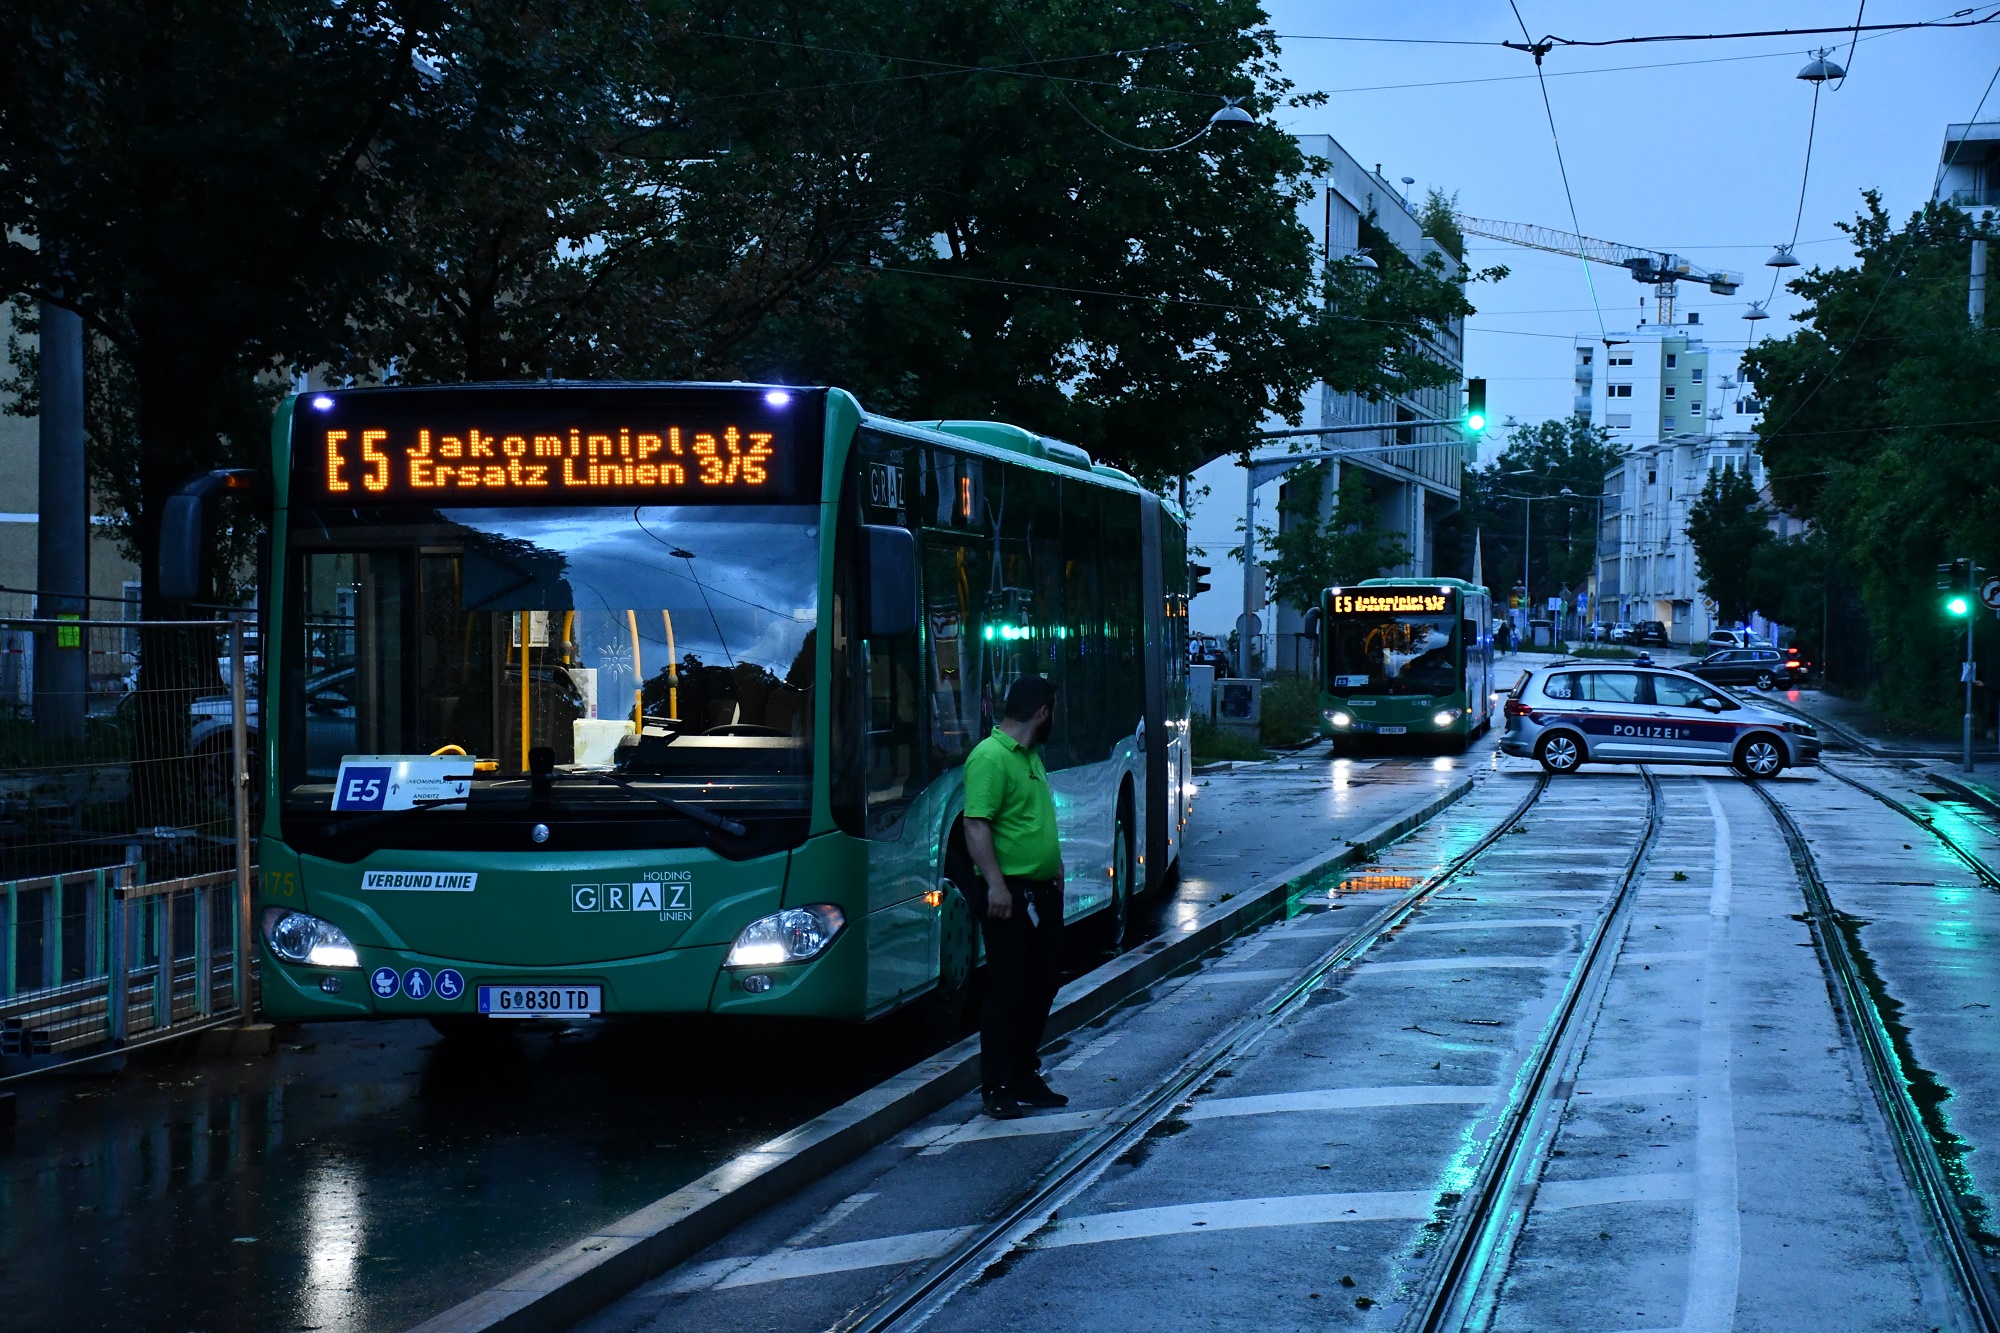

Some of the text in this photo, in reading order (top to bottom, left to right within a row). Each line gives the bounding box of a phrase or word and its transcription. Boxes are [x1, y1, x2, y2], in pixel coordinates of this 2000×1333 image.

[406, 427, 774, 459] Jakominiplatz
[410, 456, 767, 487] Ersatz Linien 3/5
[870, 468, 905, 505] GRAZ
[1613, 724, 1679, 739] POLIZEI
[346, 779, 382, 802] E5
[264, 872, 295, 897] 175
[368, 874, 472, 889] VERBUND LINIE
[643, 871, 692, 881] HOLDING
[574, 885, 687, 911] GRAZ
[659, 912, 692, 922] LINIEN
